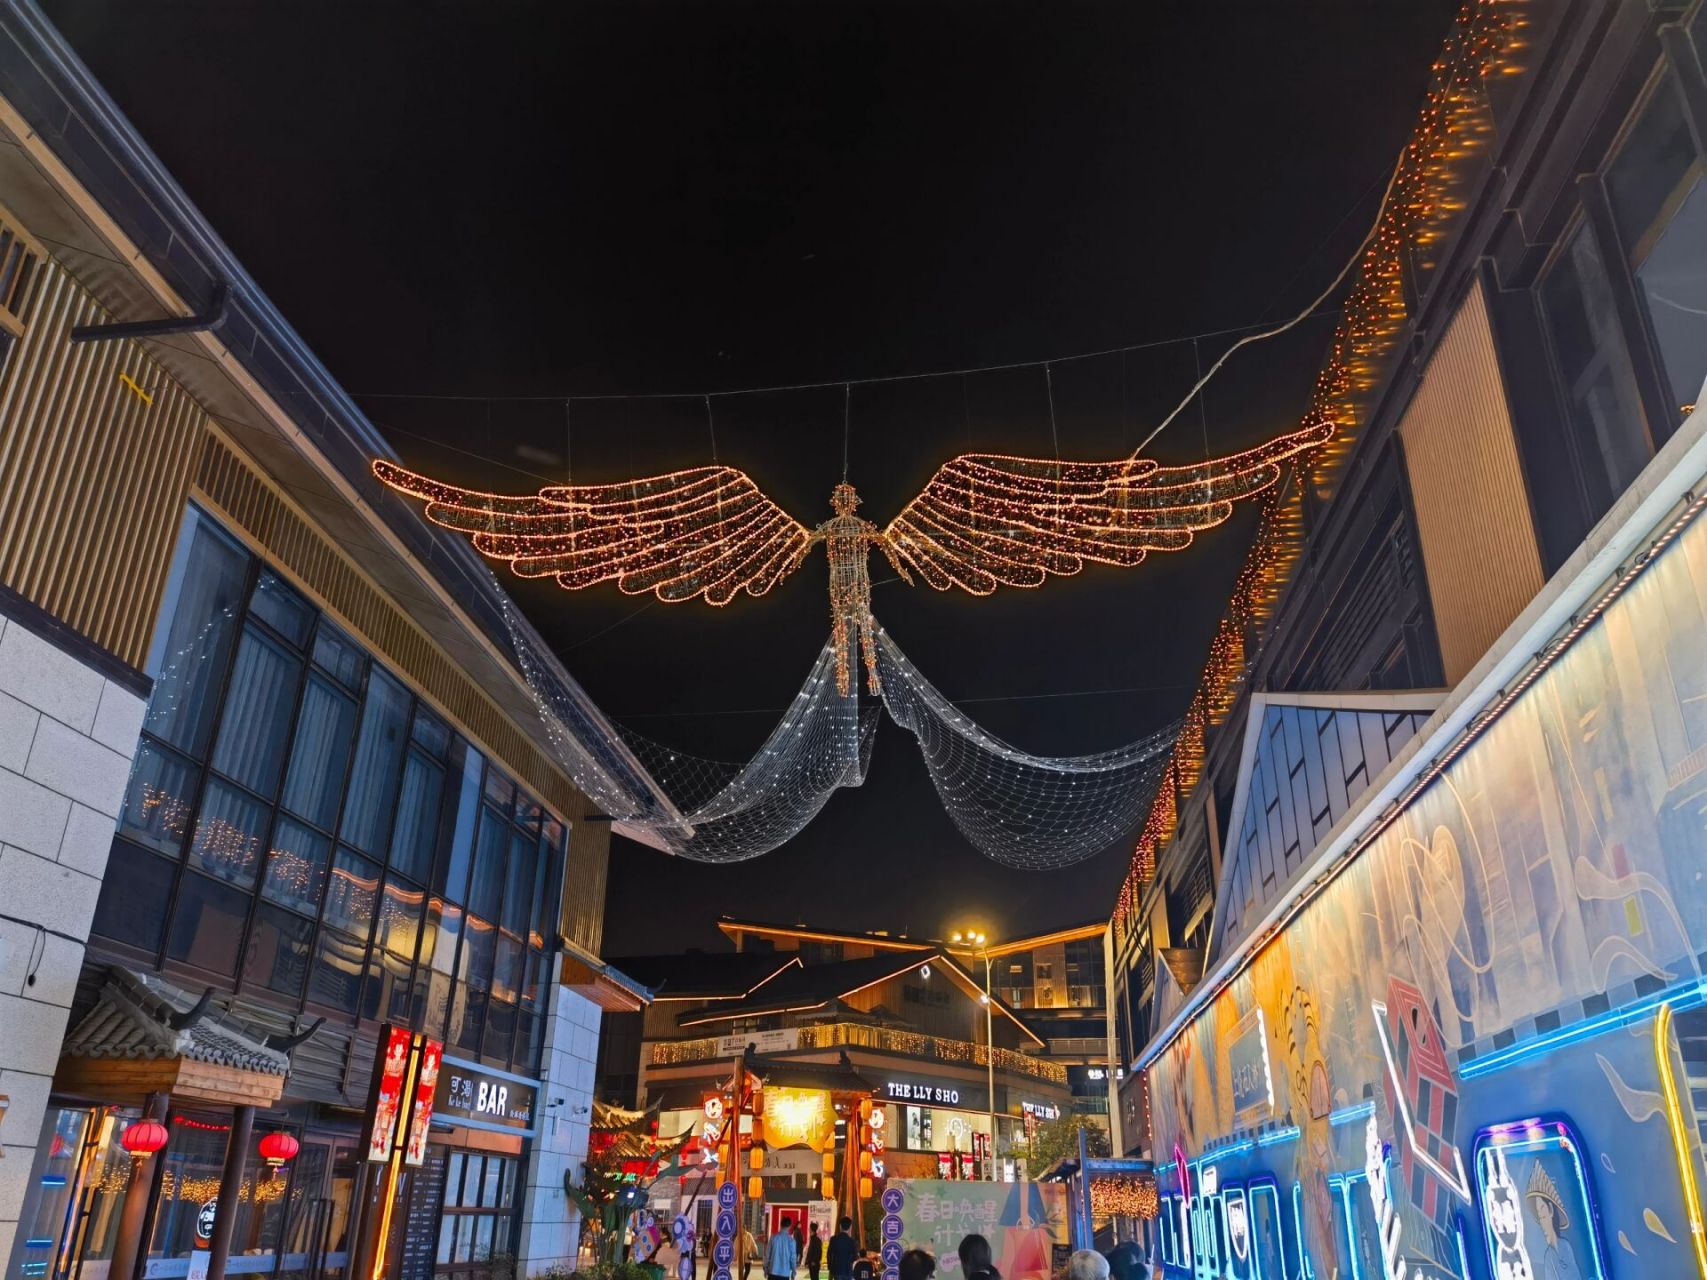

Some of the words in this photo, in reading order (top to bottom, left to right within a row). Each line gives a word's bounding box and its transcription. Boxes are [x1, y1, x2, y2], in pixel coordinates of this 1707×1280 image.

[477, 1081, 508, 1116] BAR
[887, 1082, 911, 1098] THE
[913, 1086, 932, 1100] LLY
[936, 1088, 959, 1104] SHO
[915, 1192, 998, 1223] 春日唤醒
